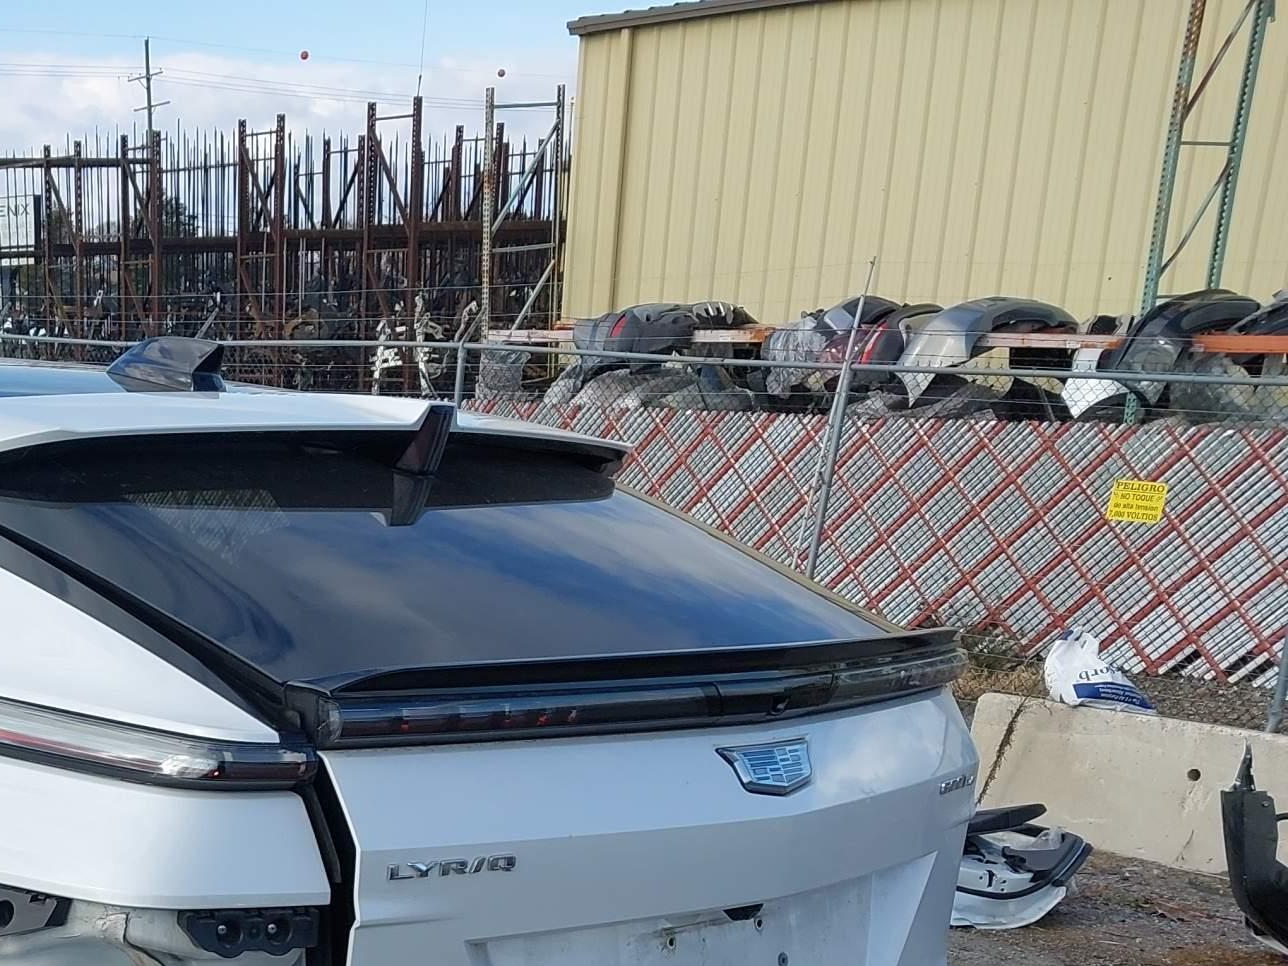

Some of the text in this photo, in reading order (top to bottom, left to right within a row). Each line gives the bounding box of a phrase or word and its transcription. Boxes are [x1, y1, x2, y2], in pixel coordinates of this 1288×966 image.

[1116, 481, 1165, 493] PELIGRO
[1132, 494, 1154, 502] TOQUE
[1127, 511, 1158, 521] VOLTIOS
